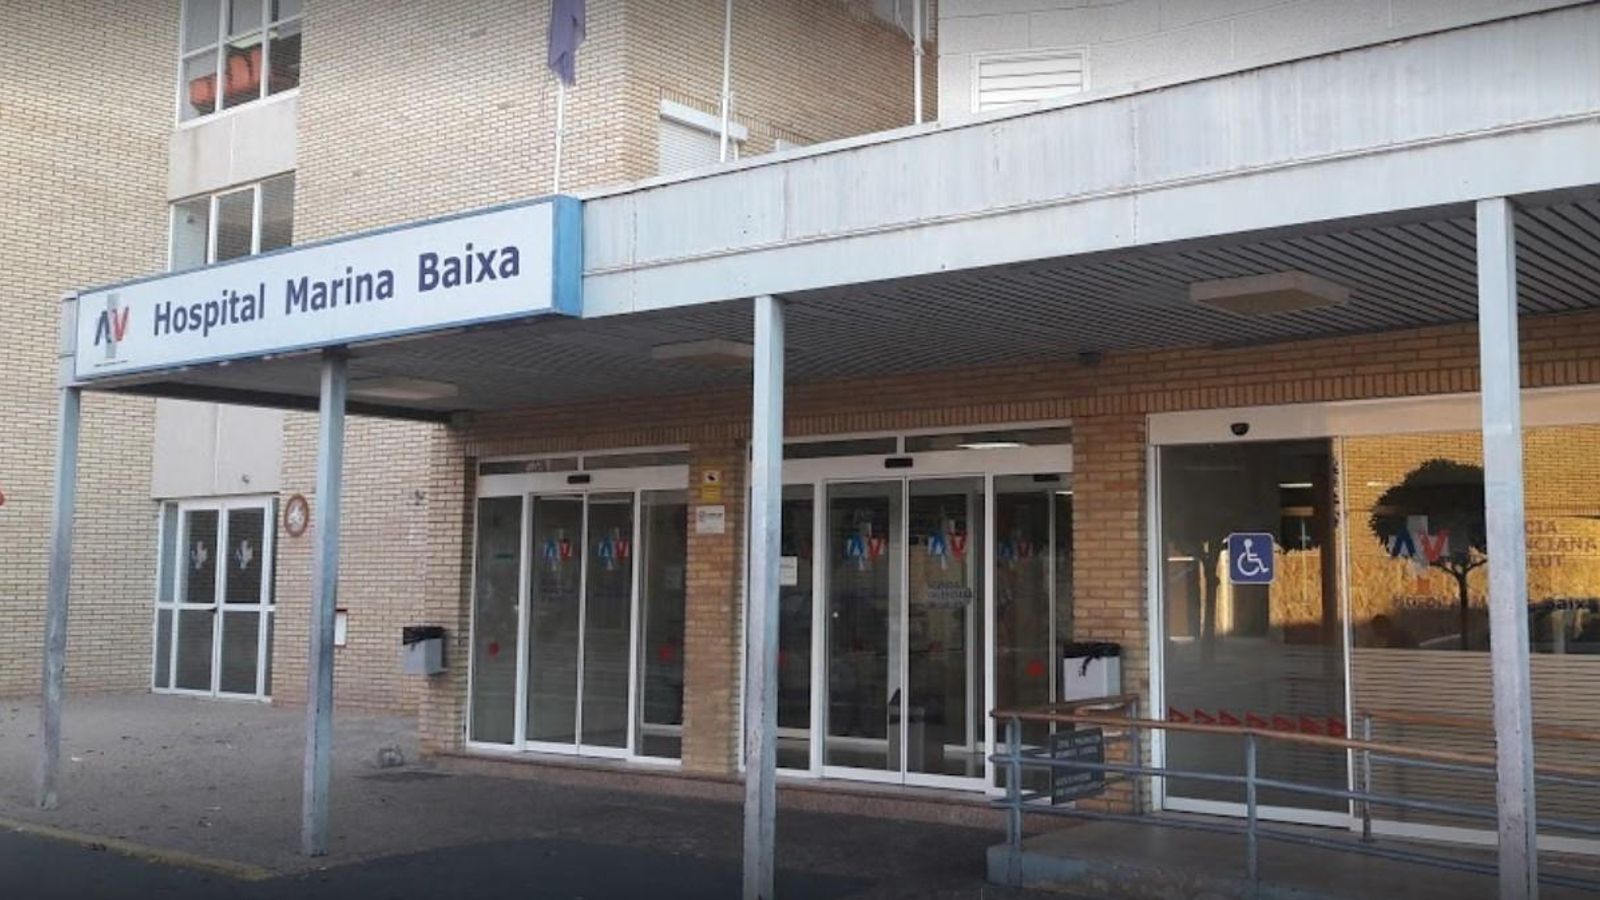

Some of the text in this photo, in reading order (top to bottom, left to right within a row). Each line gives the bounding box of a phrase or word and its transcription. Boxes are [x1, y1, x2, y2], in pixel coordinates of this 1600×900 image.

[154, 243, 520, 337] Hospital Marina Baixa
